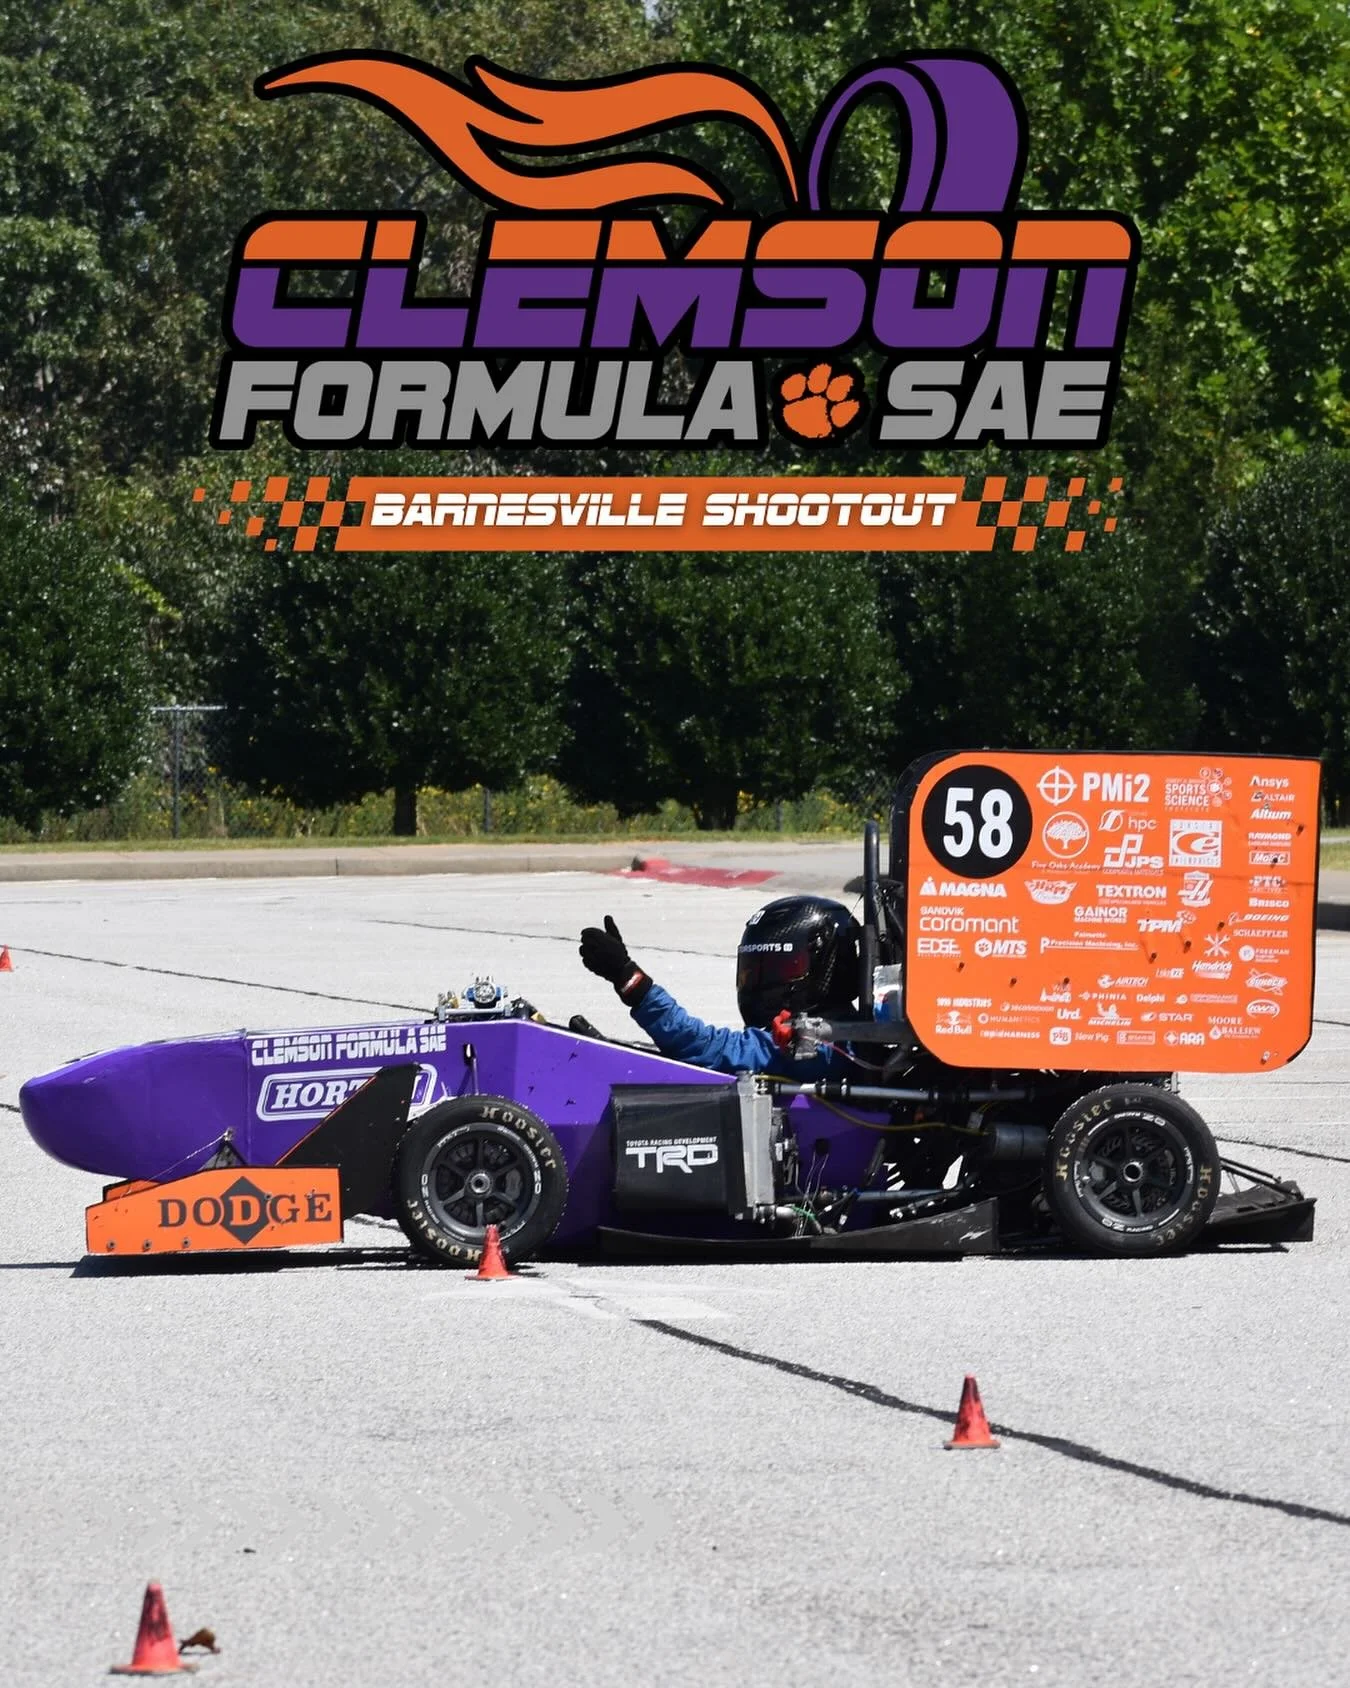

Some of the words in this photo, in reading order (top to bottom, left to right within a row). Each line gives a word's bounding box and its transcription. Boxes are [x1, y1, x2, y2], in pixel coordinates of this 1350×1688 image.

[1082, 772, 1151, 803] PMi2
[1249, 775, 1290, 789] Ansys
[1165, 783, 1207, 796] SPORTS
[1164, 794, 1210, 807] SCIENCE
[1263, 793, 1296, 802] ALTAIR
[943, 787, 1013, 858] 58
[1128, 815, 1158, 833] hpc
[1125, 855, 1164, 869] JPS
[938, 882, 1008, 898] MAGNA
[1096, 884, 1167, 899] TEXTRON
[920, 906, 965, 916] SANDVIK
[1074, 906, 1128, 918] GAINOR
[1243, 913, 1291, 922] BOEING
[1137, 919, 1184, 933] TPM
[993, 939, 1028, 955] MTS
[1136, 993, 1167, 1004] Delphi
[1158, 1013, 1194, 1022] STAR
[935, 1024, 953, 1035] Red
[953, 1024, 973, 1035] Bull
[252, 1034, 333, 1066] CLEMSON
[335, 1028, 418, 1060] FORMULA
[419, 1025, 447, 1053] SAE
[1180, 1032, 1206, 1045] ARA
[626, 1139, 649, 1148] TOYOTA
[650, 1138, 673, 1146] RACING
[673, 1136, 718, 1145] DEVELOPMENT
[625, 1143, 719, 1174] TRD
[158, 1193, 332, 1228] DODGE
